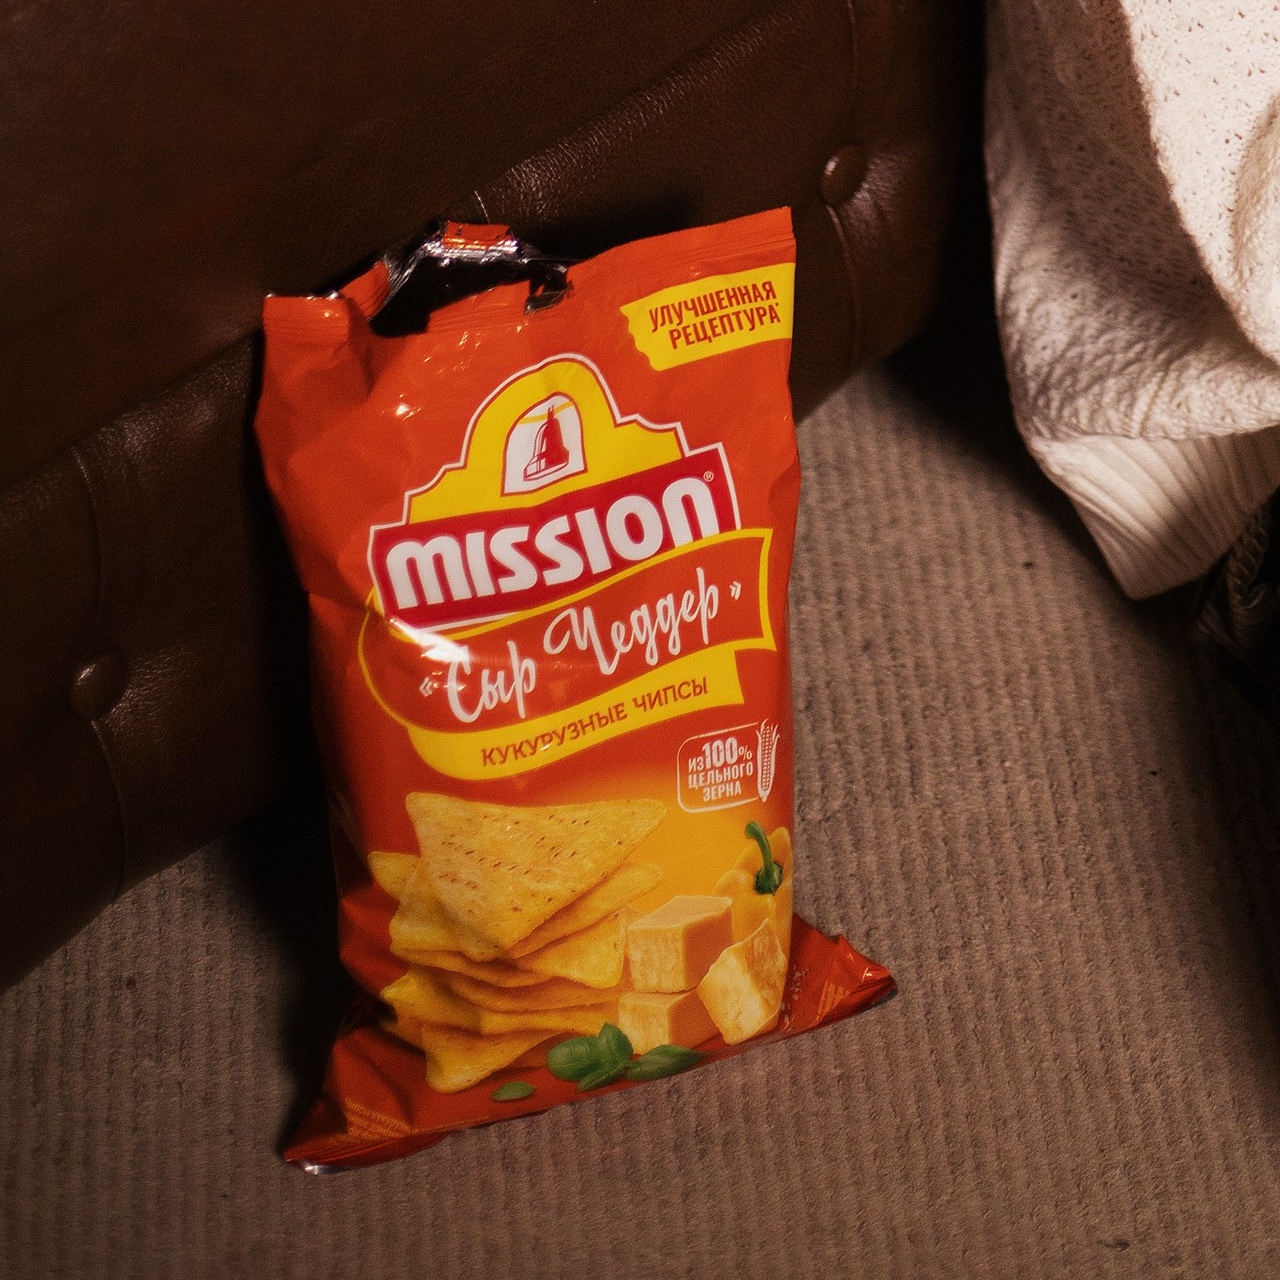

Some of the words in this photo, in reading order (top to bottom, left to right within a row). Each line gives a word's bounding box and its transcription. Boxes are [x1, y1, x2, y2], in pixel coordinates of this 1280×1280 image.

[649, 281, 777, 333] УЛУЧШЕННАЯ
[669, 303, 781, 350] РЕЦЕПТУРА
[480, 702, 628, 767] КУКУРУЗНЫЕ
[632, 677, 708, 713] ЧИПСЫ
[688, 761, 754, 790] ЦЕЛЬНОГО
[703, 781, 742, 802] ЗЕРНА
